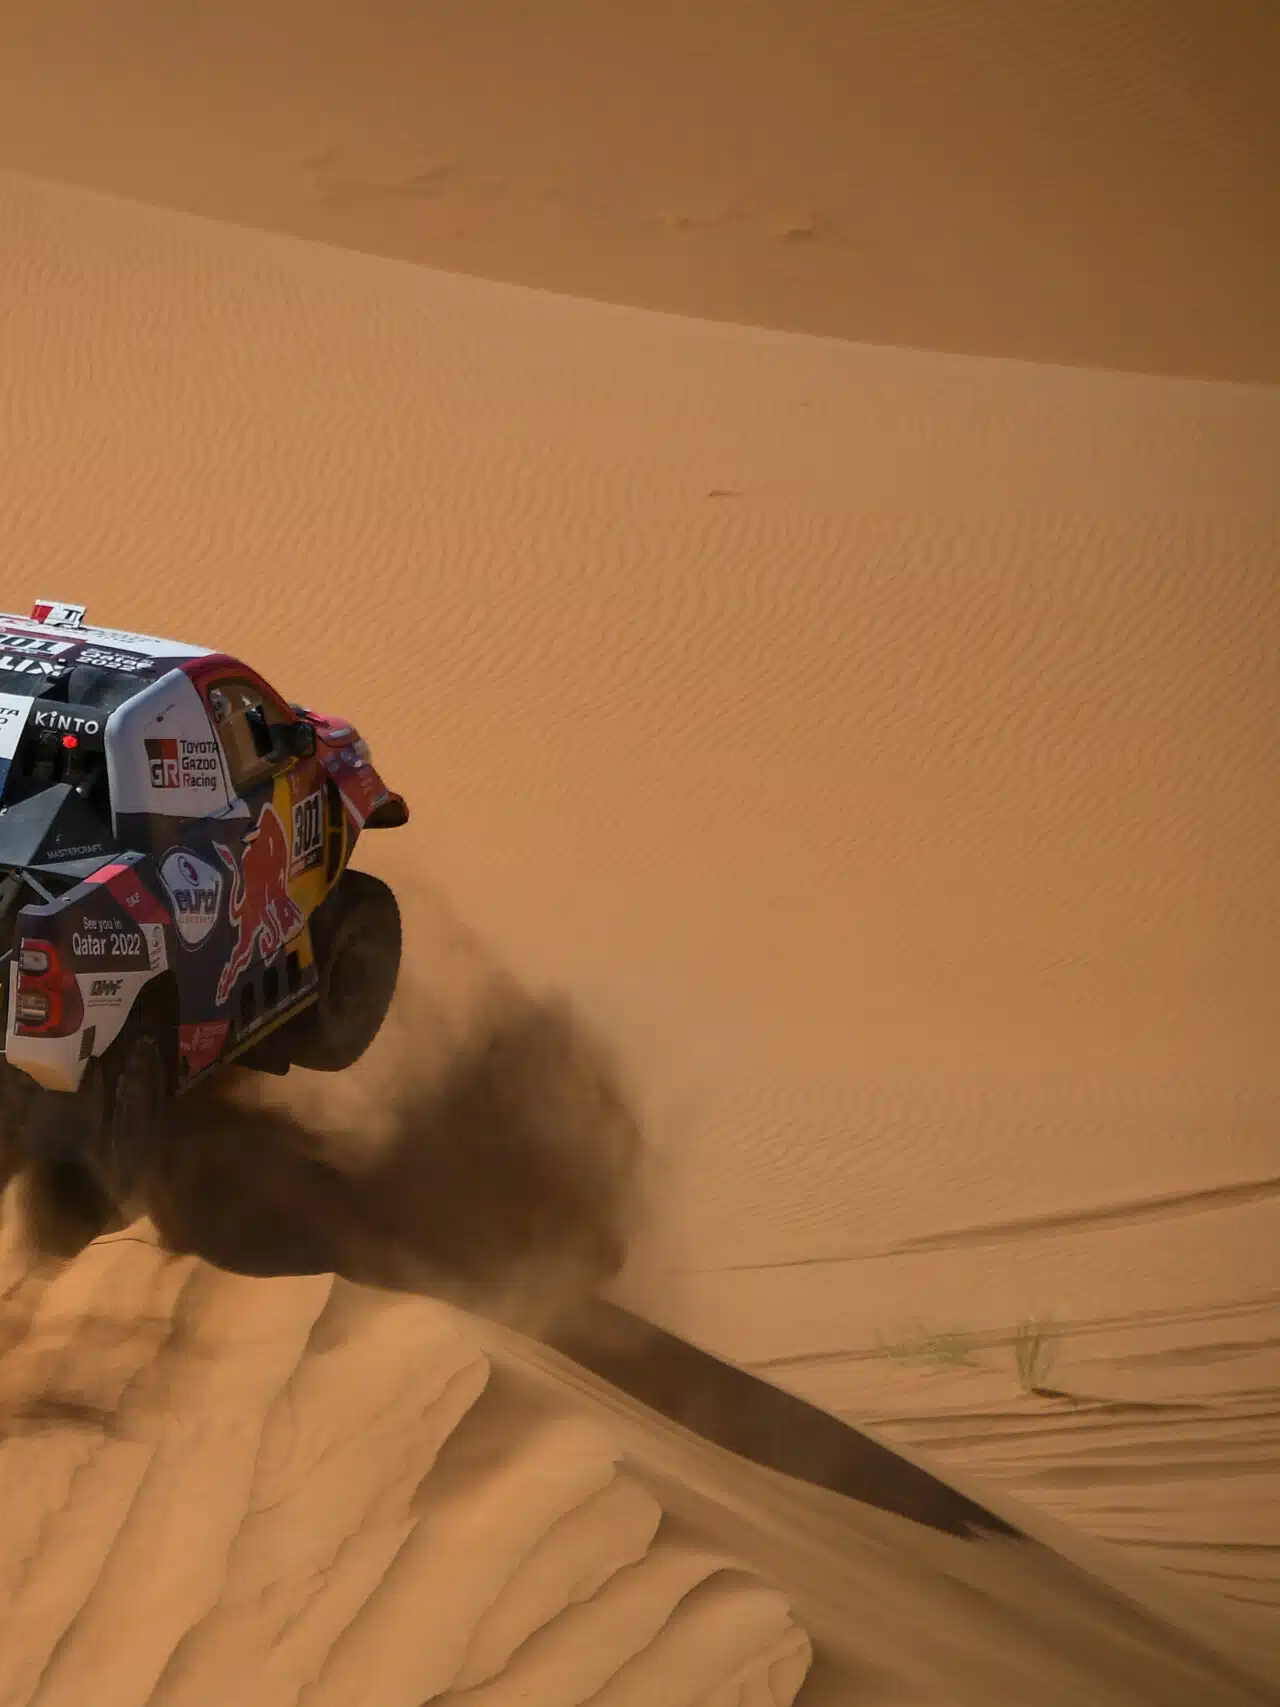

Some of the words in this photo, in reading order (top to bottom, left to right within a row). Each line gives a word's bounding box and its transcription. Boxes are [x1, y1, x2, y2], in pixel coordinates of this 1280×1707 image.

[151, 759, 178, 788] GR
[183, 773, 217, 792] Racing
[293, 793, 321, 858] 301
[83, 917, 97, 930] See
[98, 918, 113, 933] you
[114, 918, 123, 930] in
[72, 932, 106, 956] Qatar
[111, 932, 141, 955] 2022
